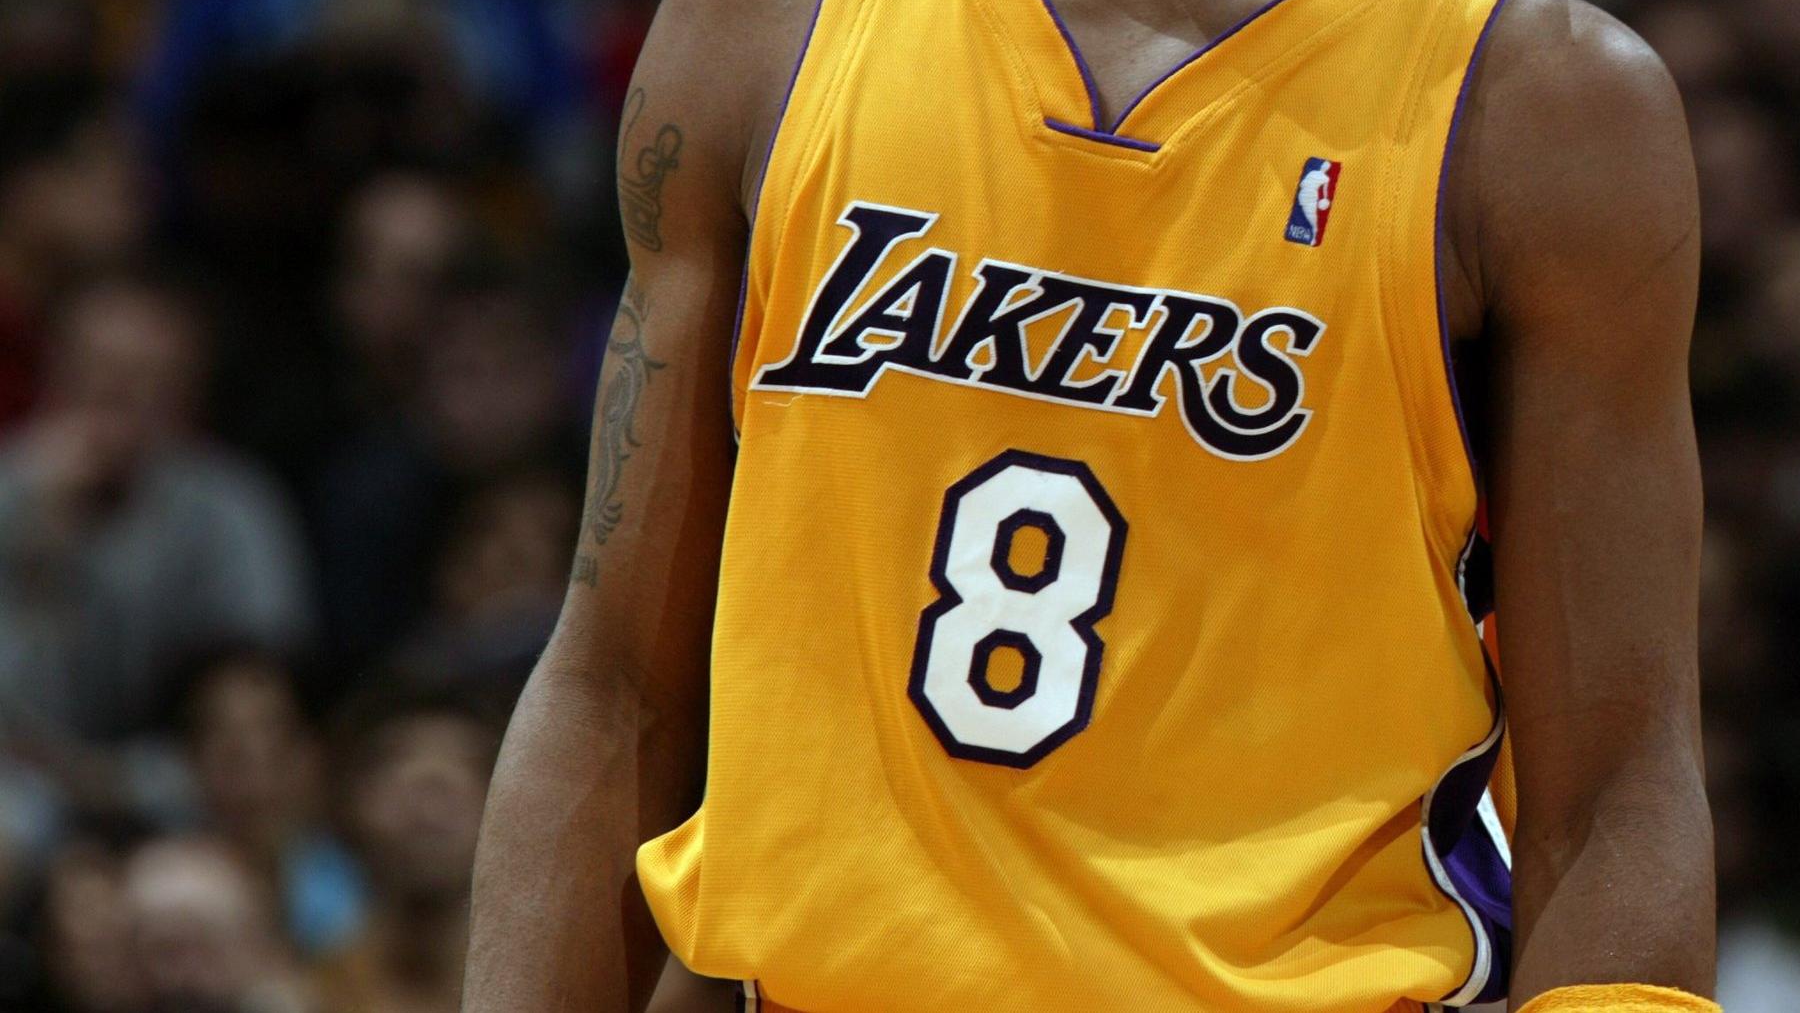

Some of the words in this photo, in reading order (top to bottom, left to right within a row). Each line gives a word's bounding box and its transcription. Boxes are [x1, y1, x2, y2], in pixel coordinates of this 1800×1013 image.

[751, 200, 1327, 461] LAKERS
[1288, 223, 1311, 241] NBA
[907, 448, 1129, 769] 8
